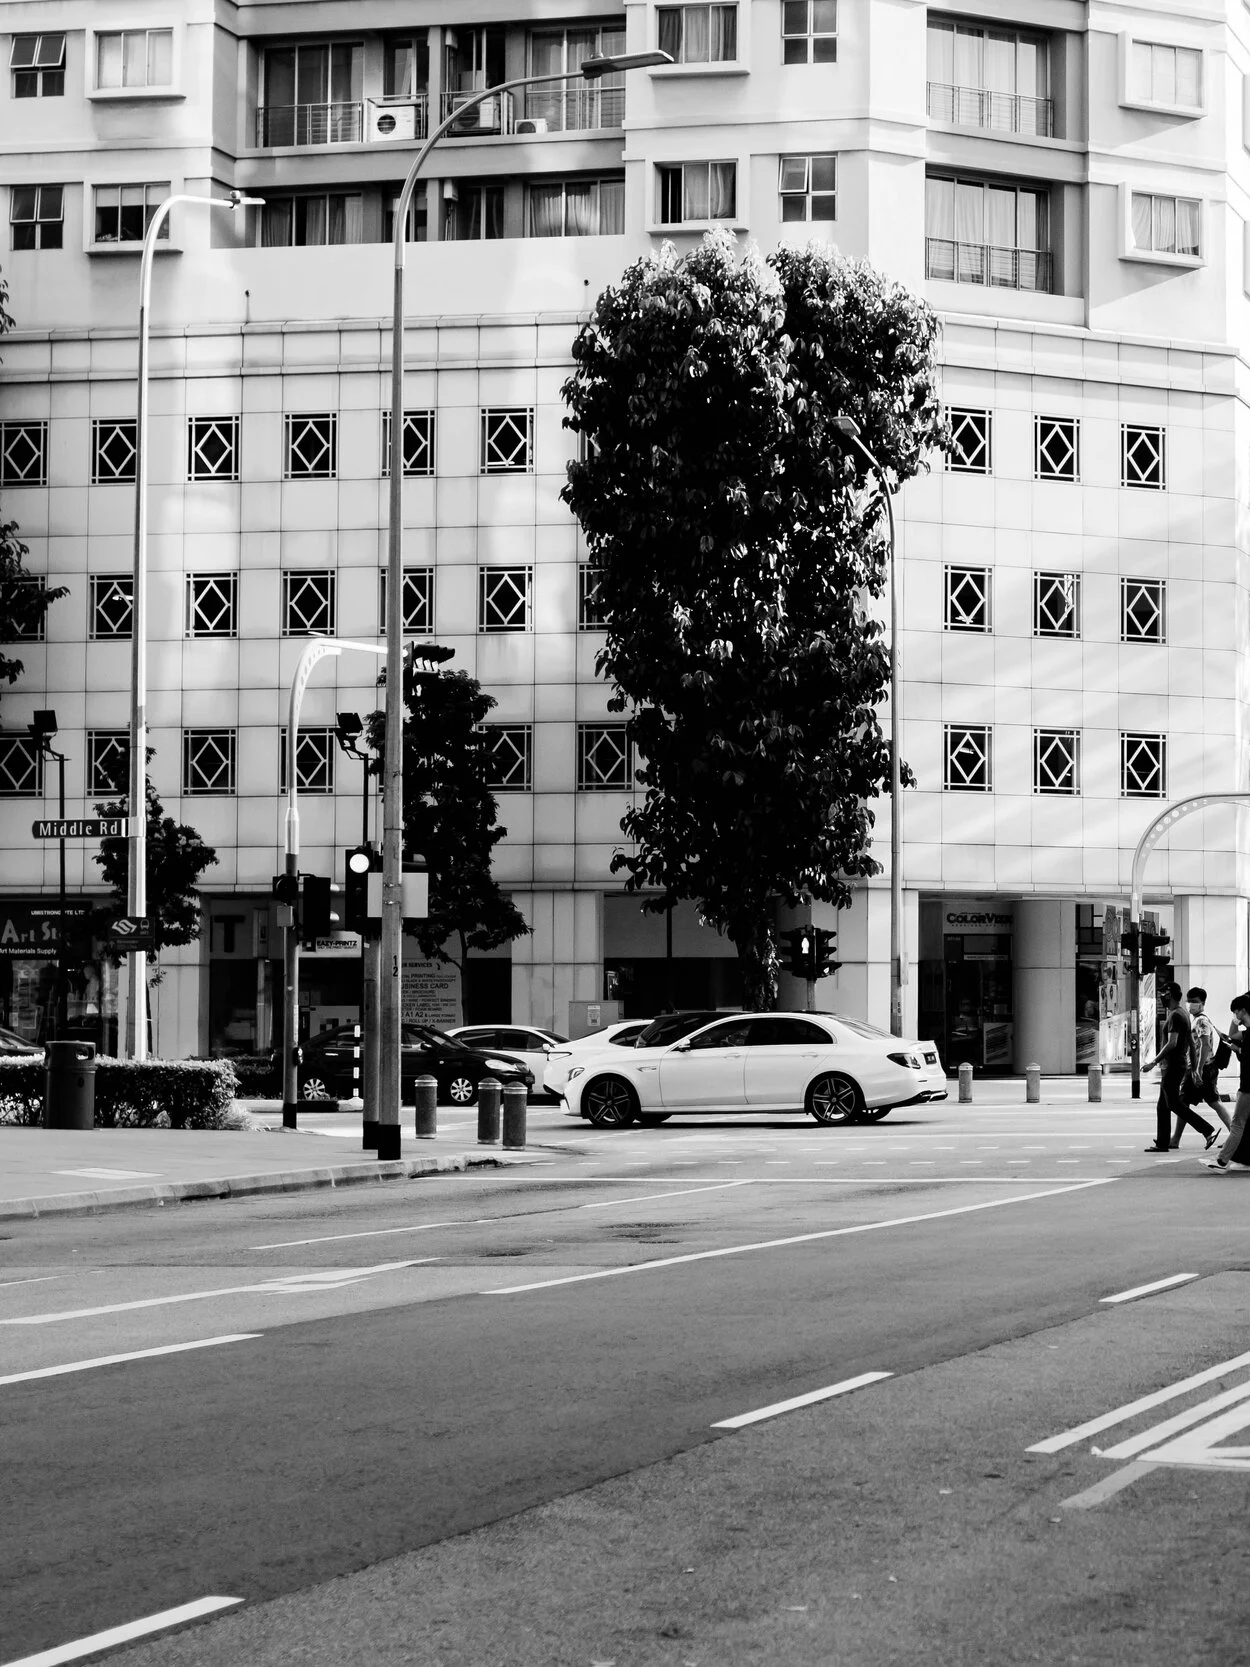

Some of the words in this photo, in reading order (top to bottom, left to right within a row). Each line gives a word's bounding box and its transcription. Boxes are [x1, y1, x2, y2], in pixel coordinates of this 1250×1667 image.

[39, 821, 93, 836] Middle
[100, 820, 118, 835] Rd
[210, 915, 245, 952] T
[37, 947, 57, 956] Supply
